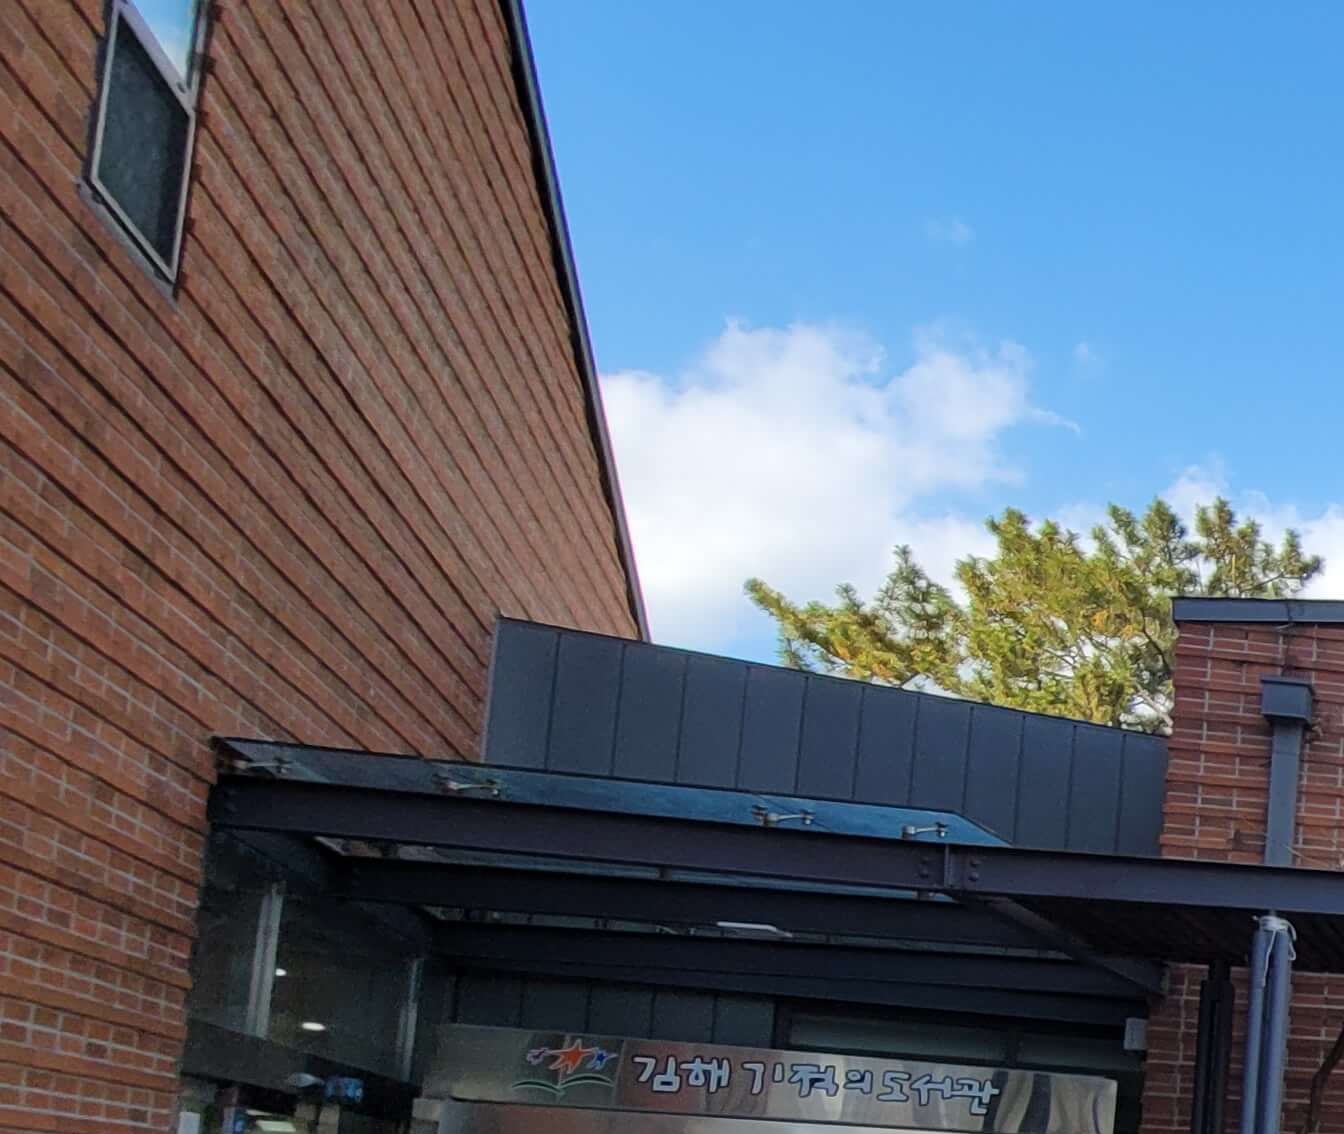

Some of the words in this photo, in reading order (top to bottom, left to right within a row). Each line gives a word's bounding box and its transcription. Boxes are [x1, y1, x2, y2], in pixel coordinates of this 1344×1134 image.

[632, 1054, 731, 1094] 김해
[742, 1062, 874, 1098] 기적의
[876, 1069, 1001, 1116] 도서관
